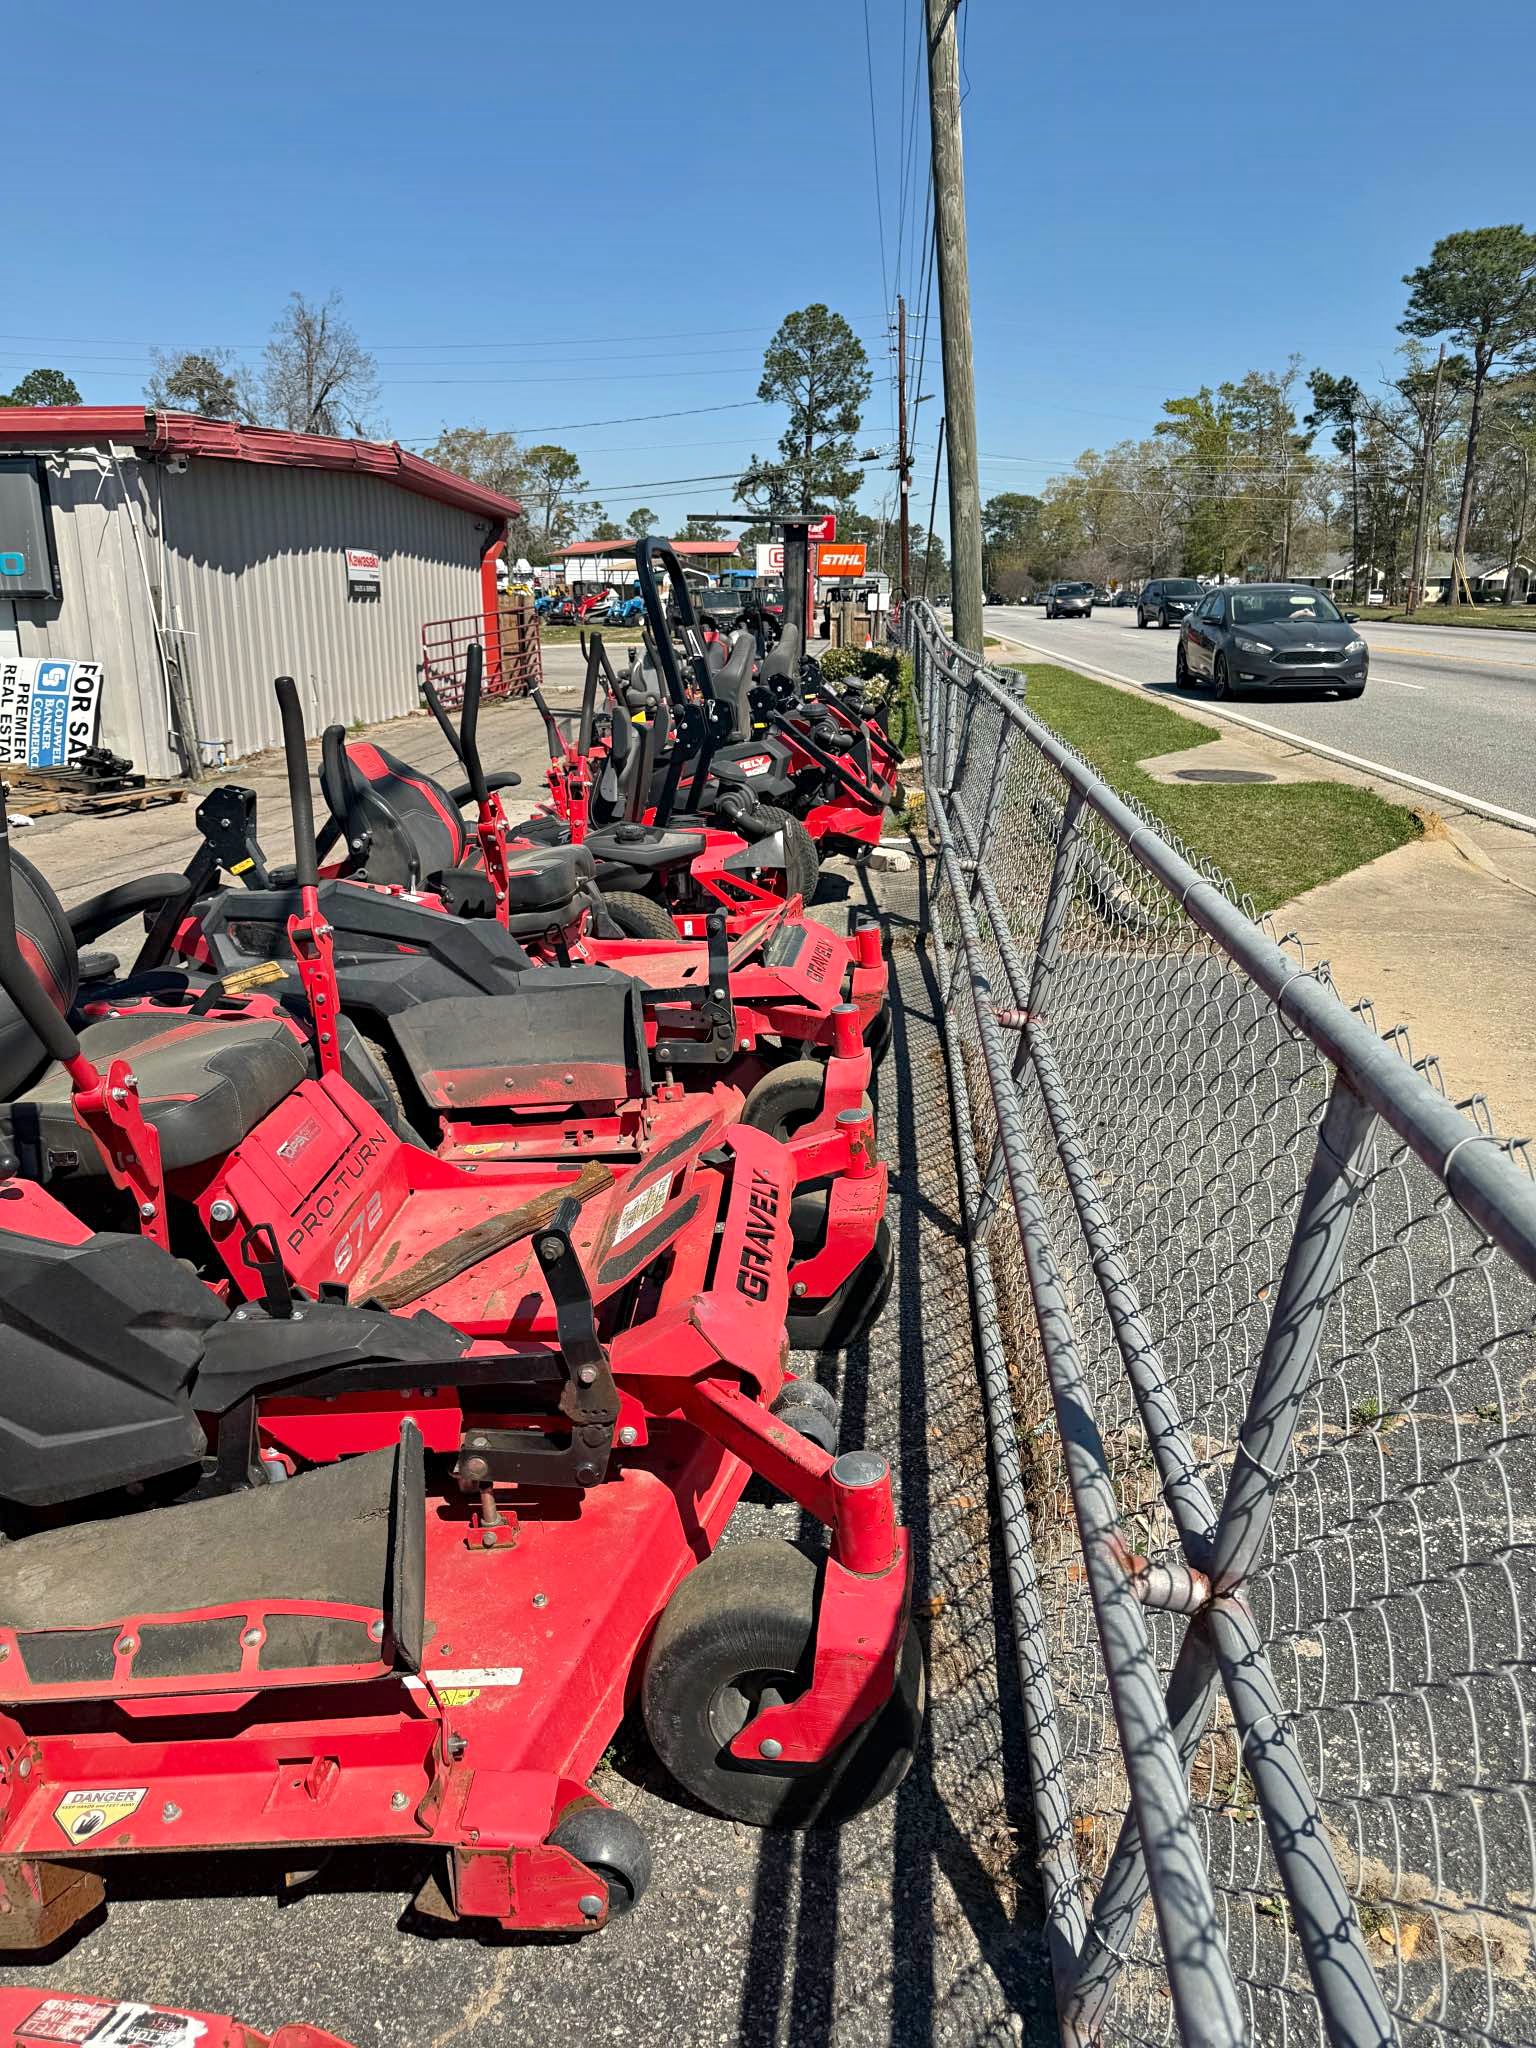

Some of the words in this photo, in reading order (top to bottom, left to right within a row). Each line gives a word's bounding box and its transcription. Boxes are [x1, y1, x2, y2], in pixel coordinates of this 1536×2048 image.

[347, 551, 379, 568] Kawasaki
[821, 554, 862, 566] STIHL
[1, 664, 17, 708] REAL
[71, 664, 98, 712] FOR
[0, 714, 12, 763] ESTAT
[14, 683, 30, 760] PREMIER
[31, 698, 44, 768] COMMERCI
[41, 698, 54, 750] BANKER
[52, 698, 66, 765] COLDWEL
[67, 721, 89, 767] SAL
[806, 937, 834, 983] GRAVELY
[287, 1129, 387, 1255] PRO-TURN
[334, 1190, 383, 1274] 672
[736, 1168, 779, 1302] GRAVELY
[71, 1791, 137, 1804] DANGER
